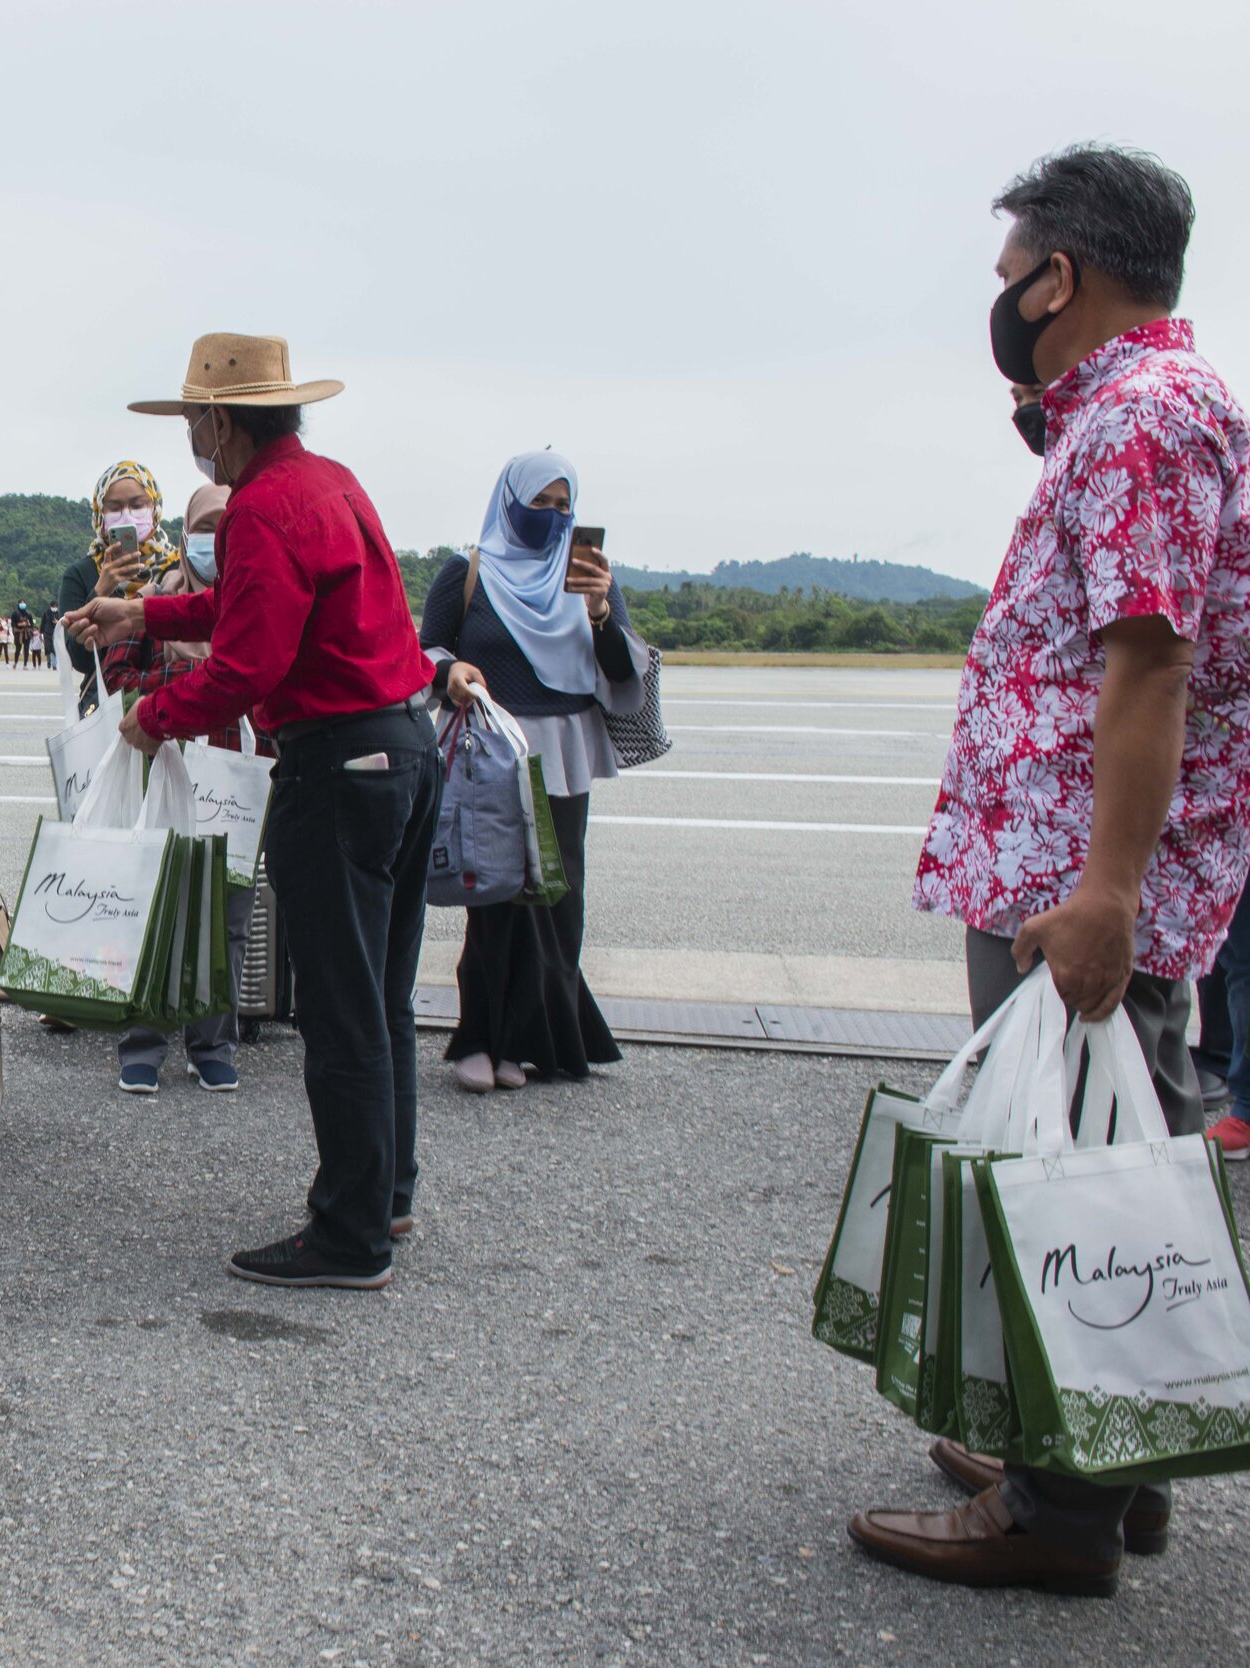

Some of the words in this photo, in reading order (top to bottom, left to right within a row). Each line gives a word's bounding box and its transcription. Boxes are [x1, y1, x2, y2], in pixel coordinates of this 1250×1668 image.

[34, 872, 135, 924] Malaysia
[92, 902, 121, 922] Truly
[1041, 1243, 1211, 1330] Malaysia
[1162, 1277, 1202, 1312] Truly
[1206, 1276, 1229, 1293] Asia
